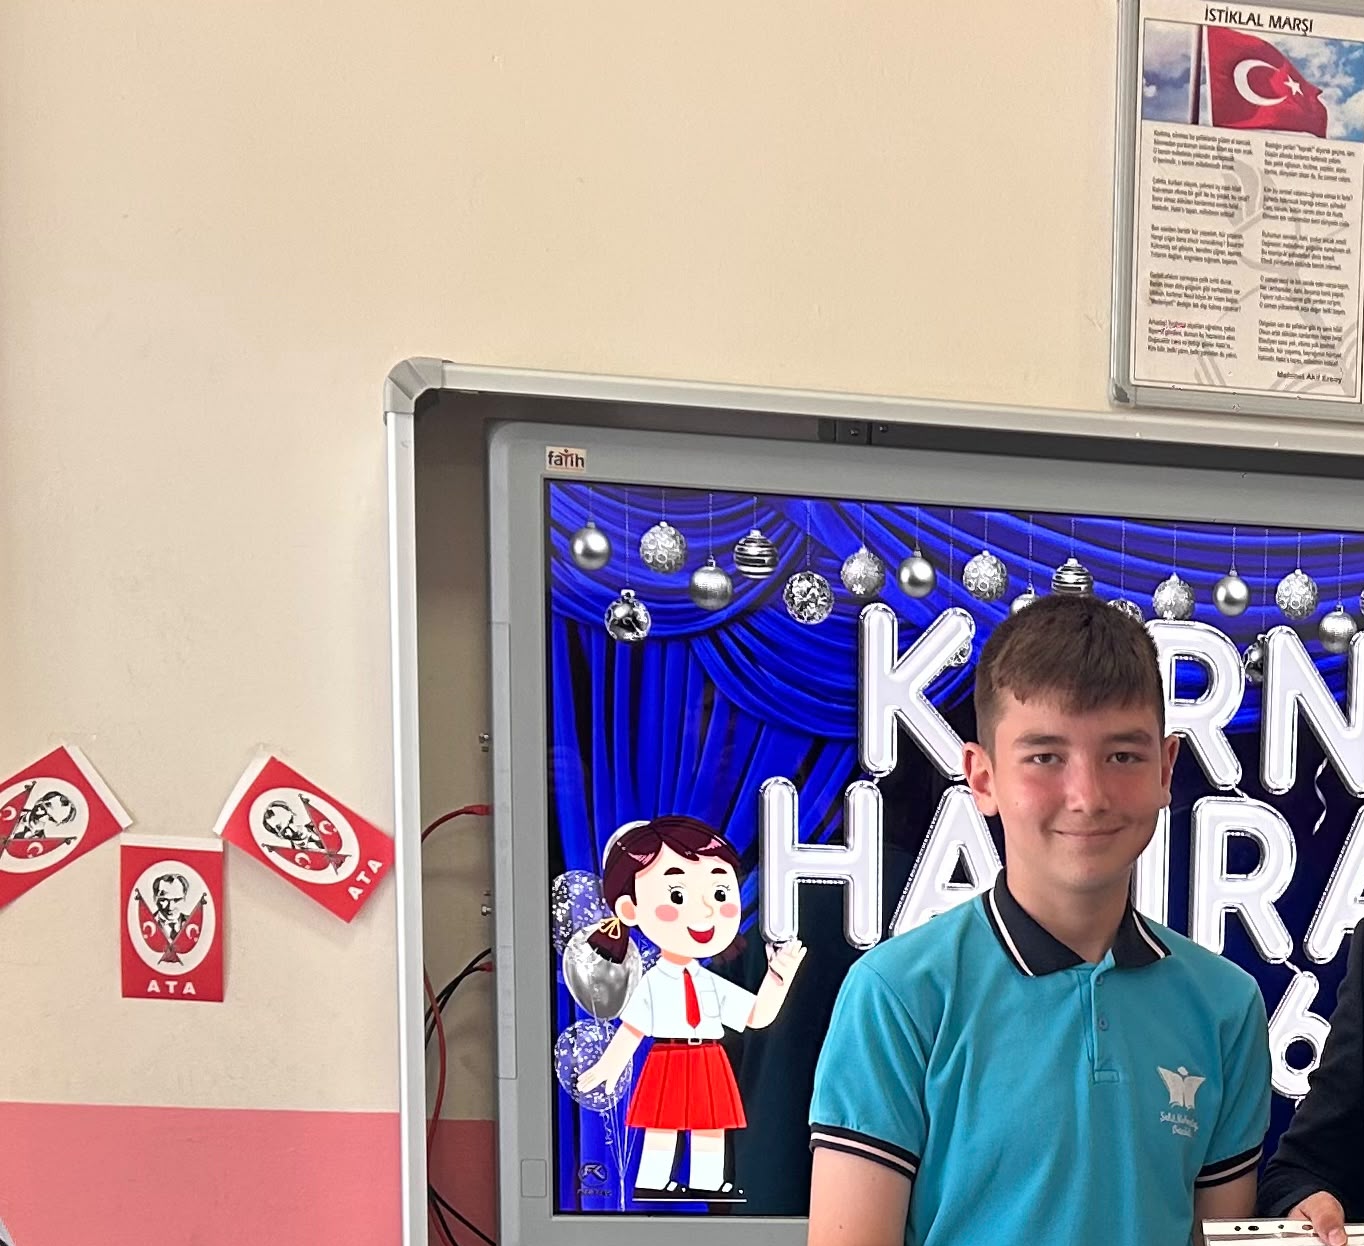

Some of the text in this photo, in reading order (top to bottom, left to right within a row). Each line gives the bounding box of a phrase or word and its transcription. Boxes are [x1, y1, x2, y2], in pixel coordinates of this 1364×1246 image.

[1204, 3, 1314, 36] İSTİKLAL MARŞI
[346, 857, 384, 902] ATA
[145, 978, 197, 996] ATA
